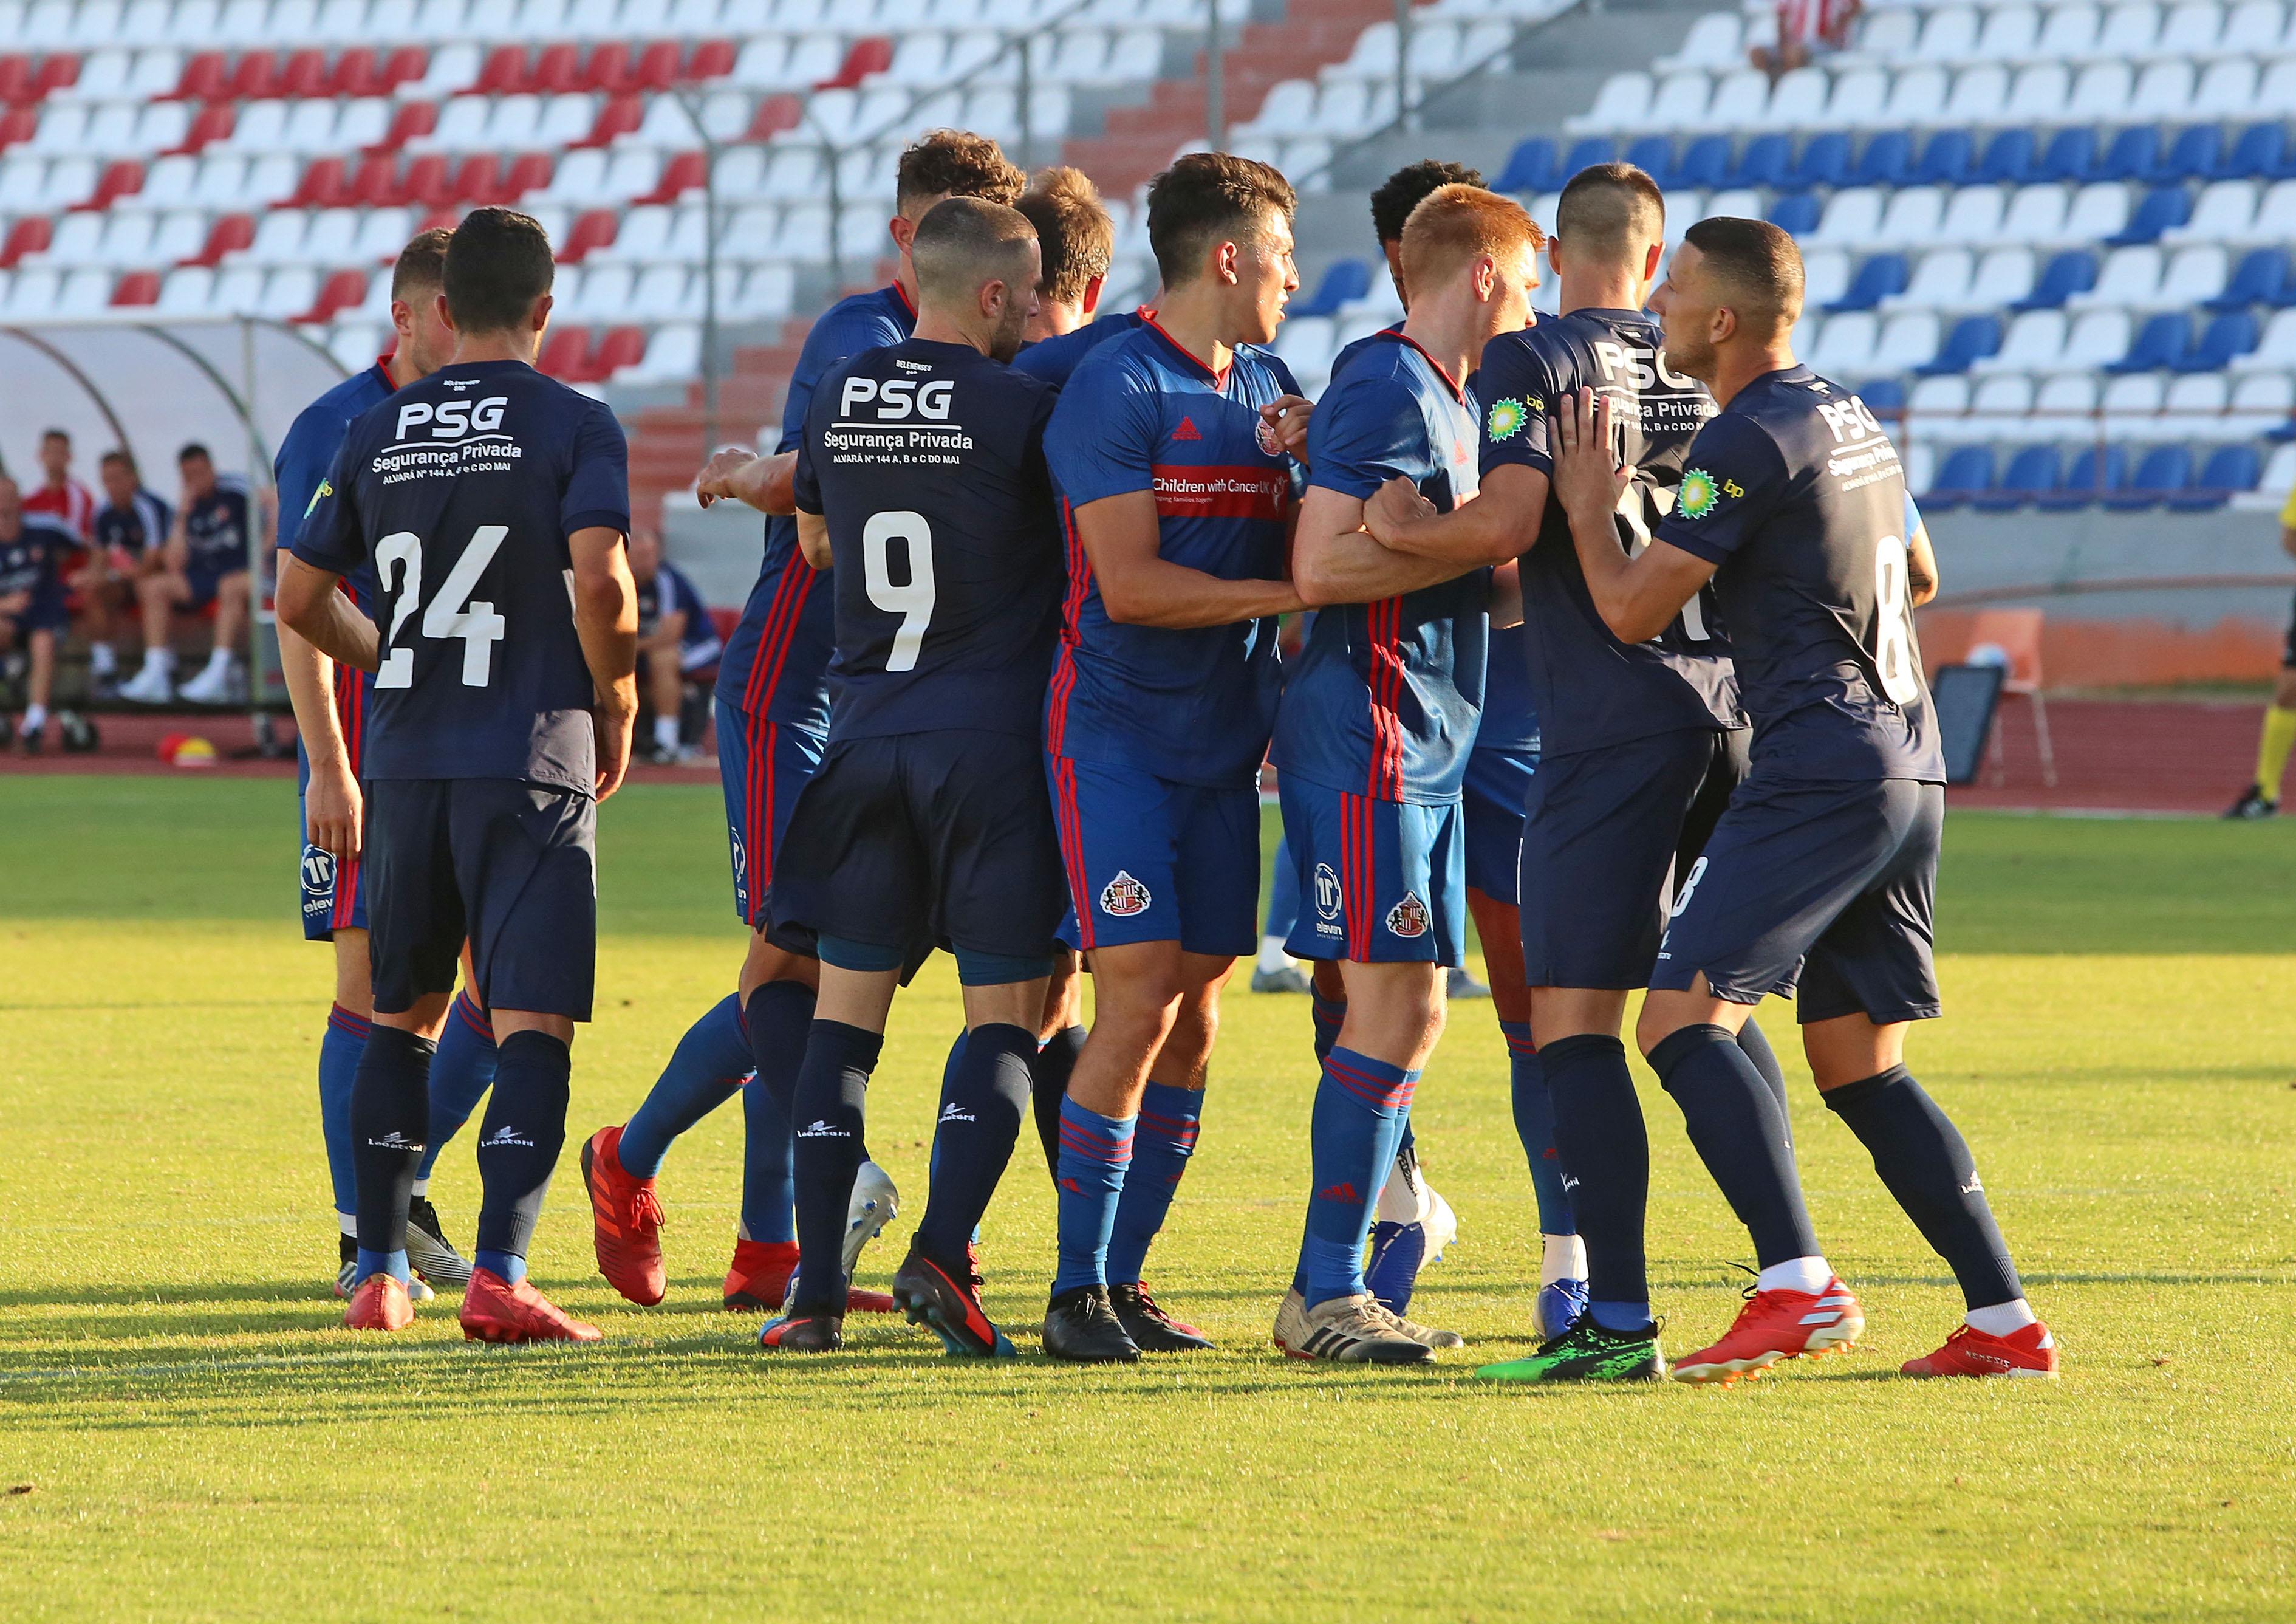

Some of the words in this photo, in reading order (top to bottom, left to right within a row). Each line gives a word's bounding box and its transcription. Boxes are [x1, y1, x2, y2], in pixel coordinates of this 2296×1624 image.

[840, 377, 955, 419] PSG
[1527, 394, 1545, 411] bp
[395, 397, 508, 440] PSG
[1658, 402, 1721, 418] Privada
[1816, 396, 1882, 442] PSG
[1654, 422, 1661, 431] B
[1680, 422, 1694, 431] DO
[824, 431, 904, 451] Segurança
[909, 431, 973, 449] Privada
[372, 451, 458, 473] Segurança
[462, 443, 522, 460] Privada
[833, 453, 862, 464] ALVARÁ
[943, 455, 960, 464] MAI
[383, 469, 415, 485] ALVARÁ
[493, 462, 511, 471] MAI
[1152, 478, 1205, 493] Children
[1207, 479, 1226, 492] with
[1228, 479, 1259, 493] Cancer
[1723, 479, 1744, 498] bp
[863, 511, 936, 672] 9
[374, 525, 510, 689] 24
[1874, 535, 1918, 705] 8
[1671, 856, 1709, 917] 8
[1316, 920, 1342, 936] eleven
